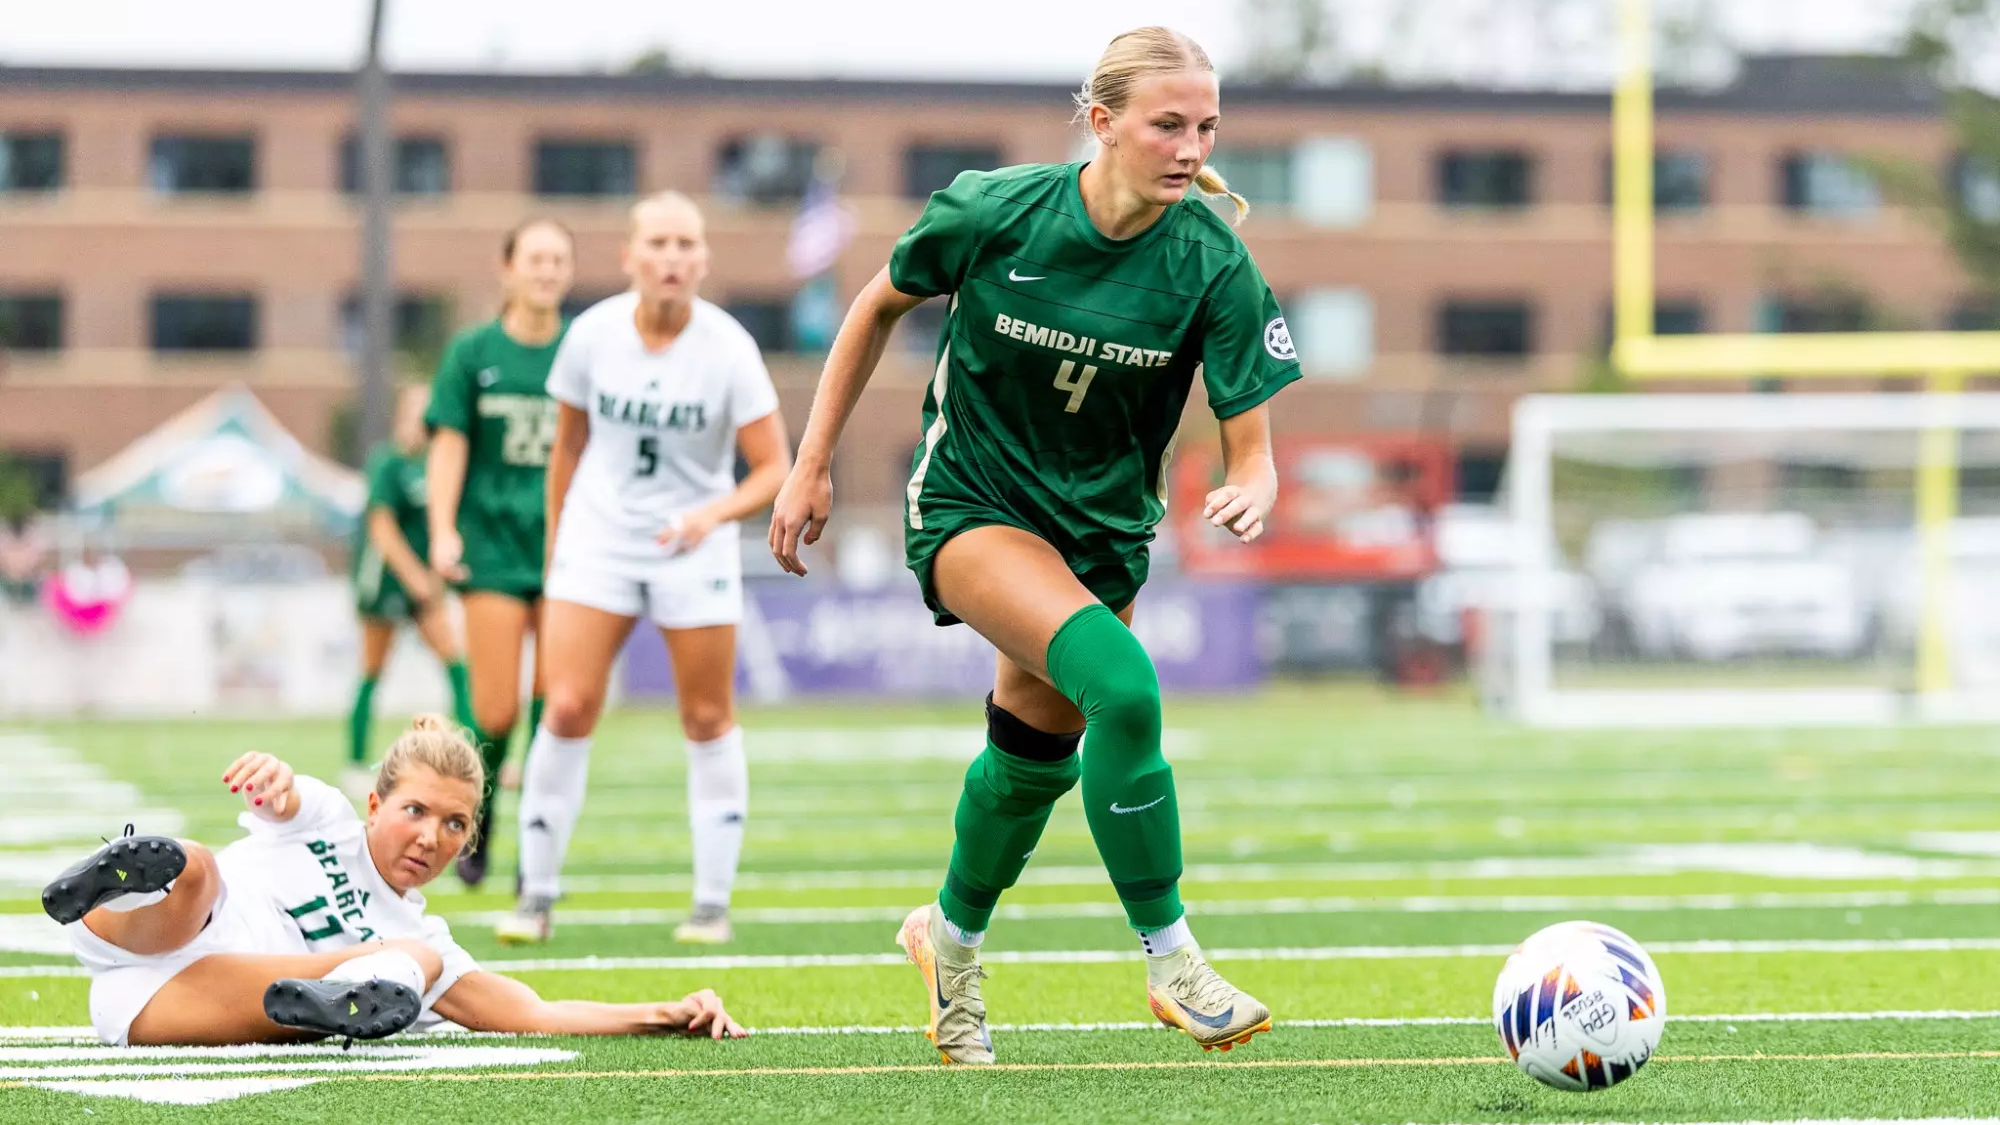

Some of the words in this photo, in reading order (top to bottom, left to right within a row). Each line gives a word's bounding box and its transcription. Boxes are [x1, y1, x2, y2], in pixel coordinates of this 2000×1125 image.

[994, 313, 1097, 357] BEMIDJI
[1099, 342, 1173, 368] STATE
[1053, 359, 1098, 414] 4
[597, 392, 707, 432] BEARCATS
[635, 436, 659, 477] 5
[305, 839, 378, 943] BEARCA
[284, 895, 345, 942] 17
[1579, 1003, 1616, 1036] GB4
